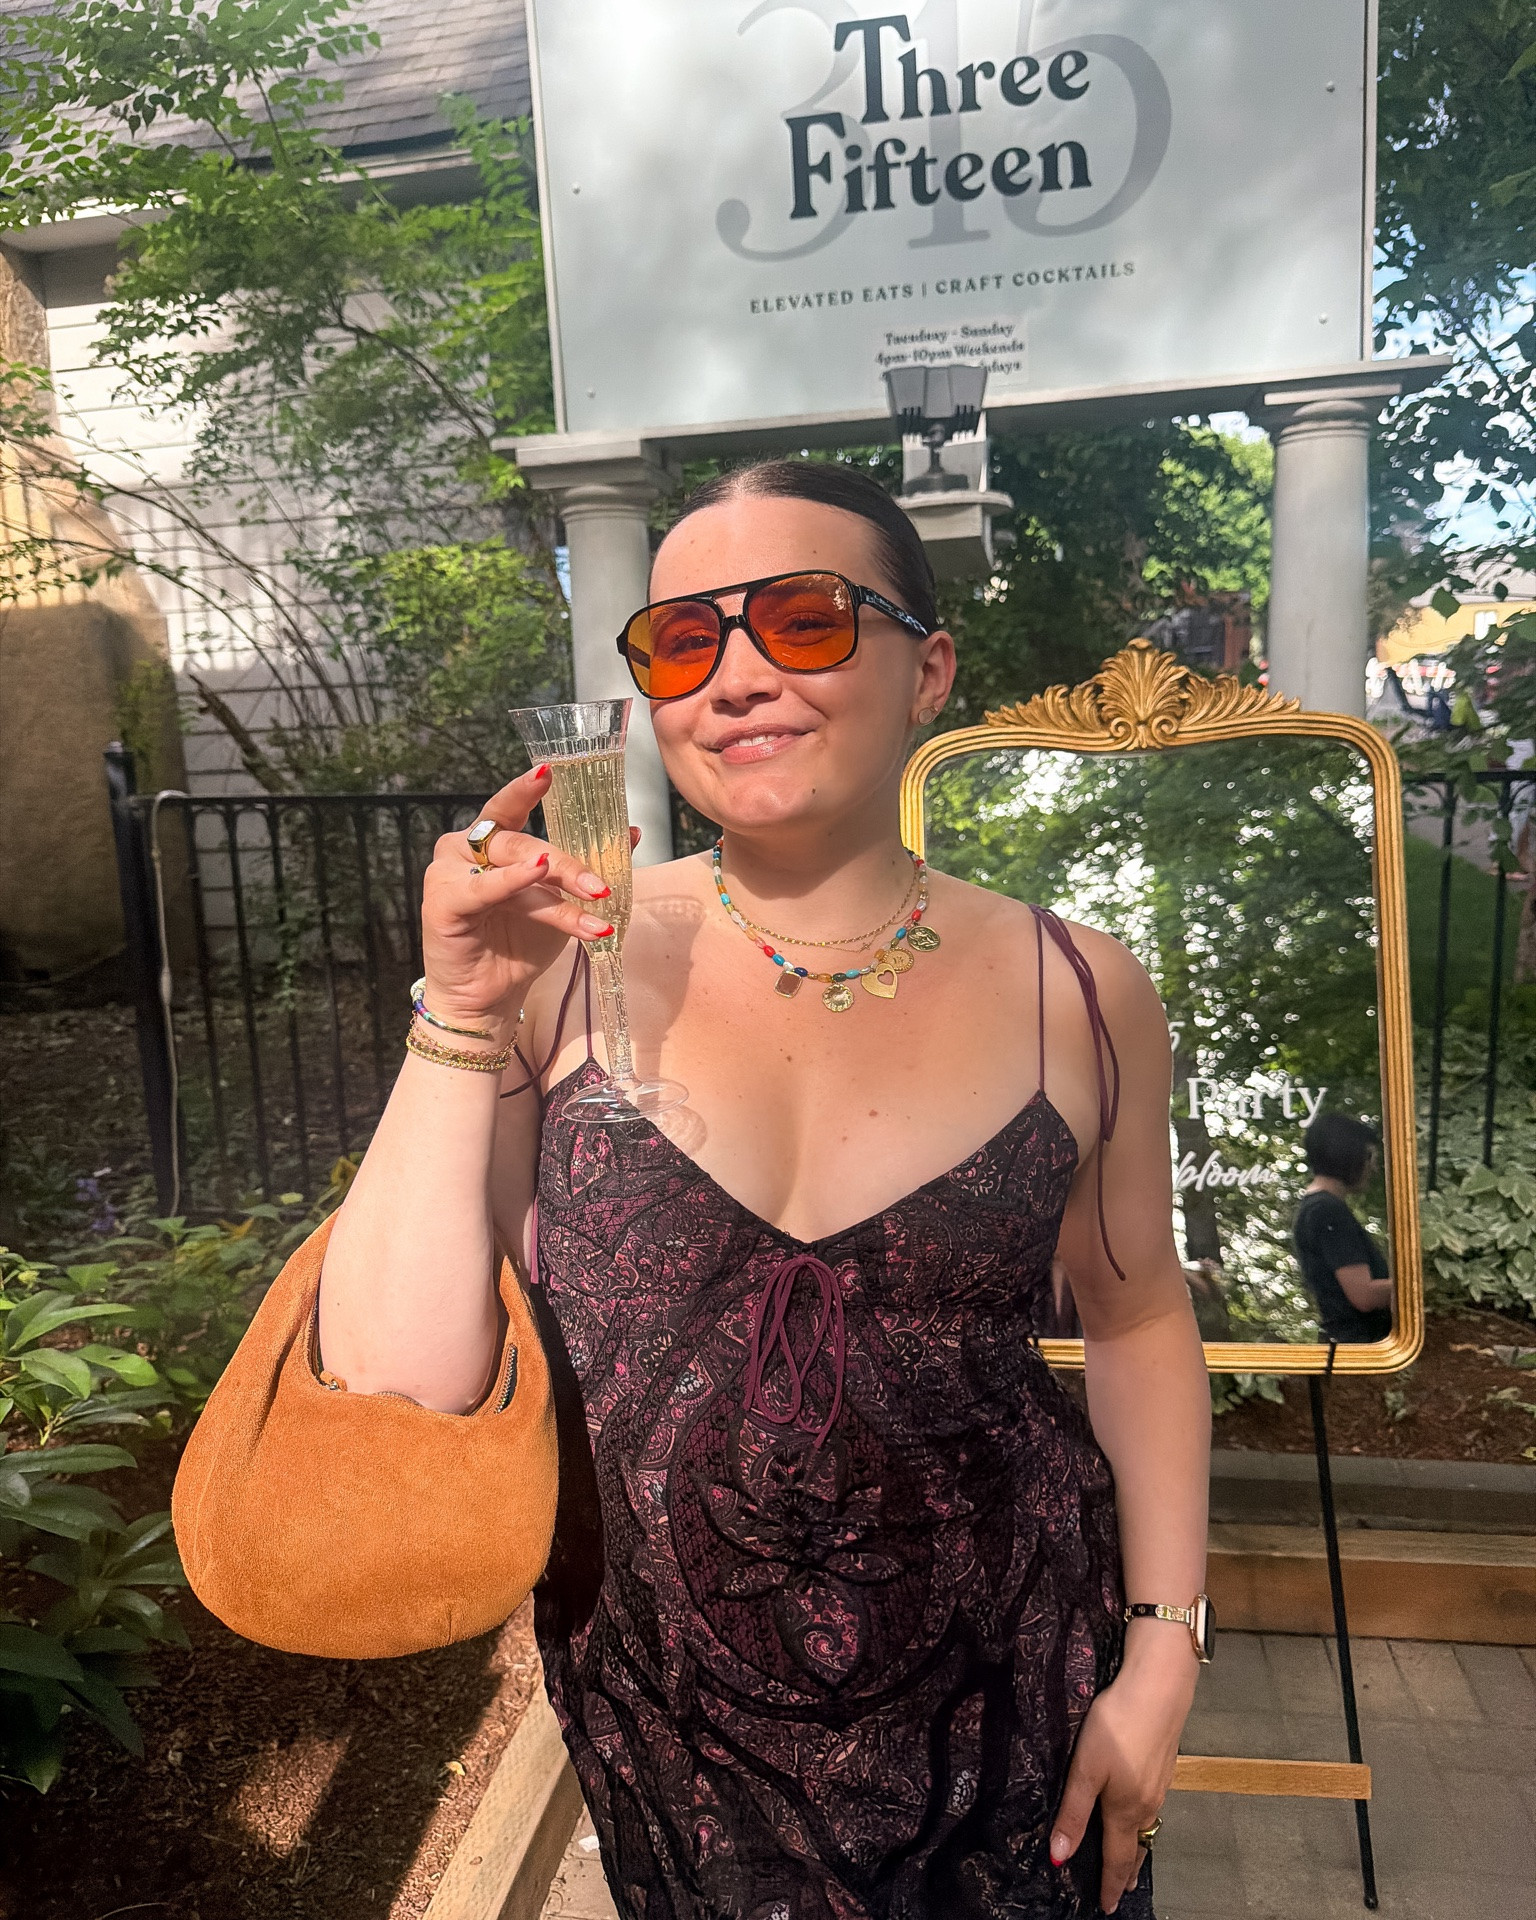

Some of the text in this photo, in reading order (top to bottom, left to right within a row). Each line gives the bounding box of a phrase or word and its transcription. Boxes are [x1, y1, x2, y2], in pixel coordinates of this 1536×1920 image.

[834, 14, 1091, 124] Three
[785, 112, 1092, 220] Fifteen
[750, 289, 854, 314] ELEVATED
[862, 284, 914, 303] EATS
[935, 275, 1004, 296] CRAFT
[1011, 261, 1136, 287] COCKTAILS
[954, 340, 1024, 356] Weekends
[960, 323, 1014, 338] Sunday
